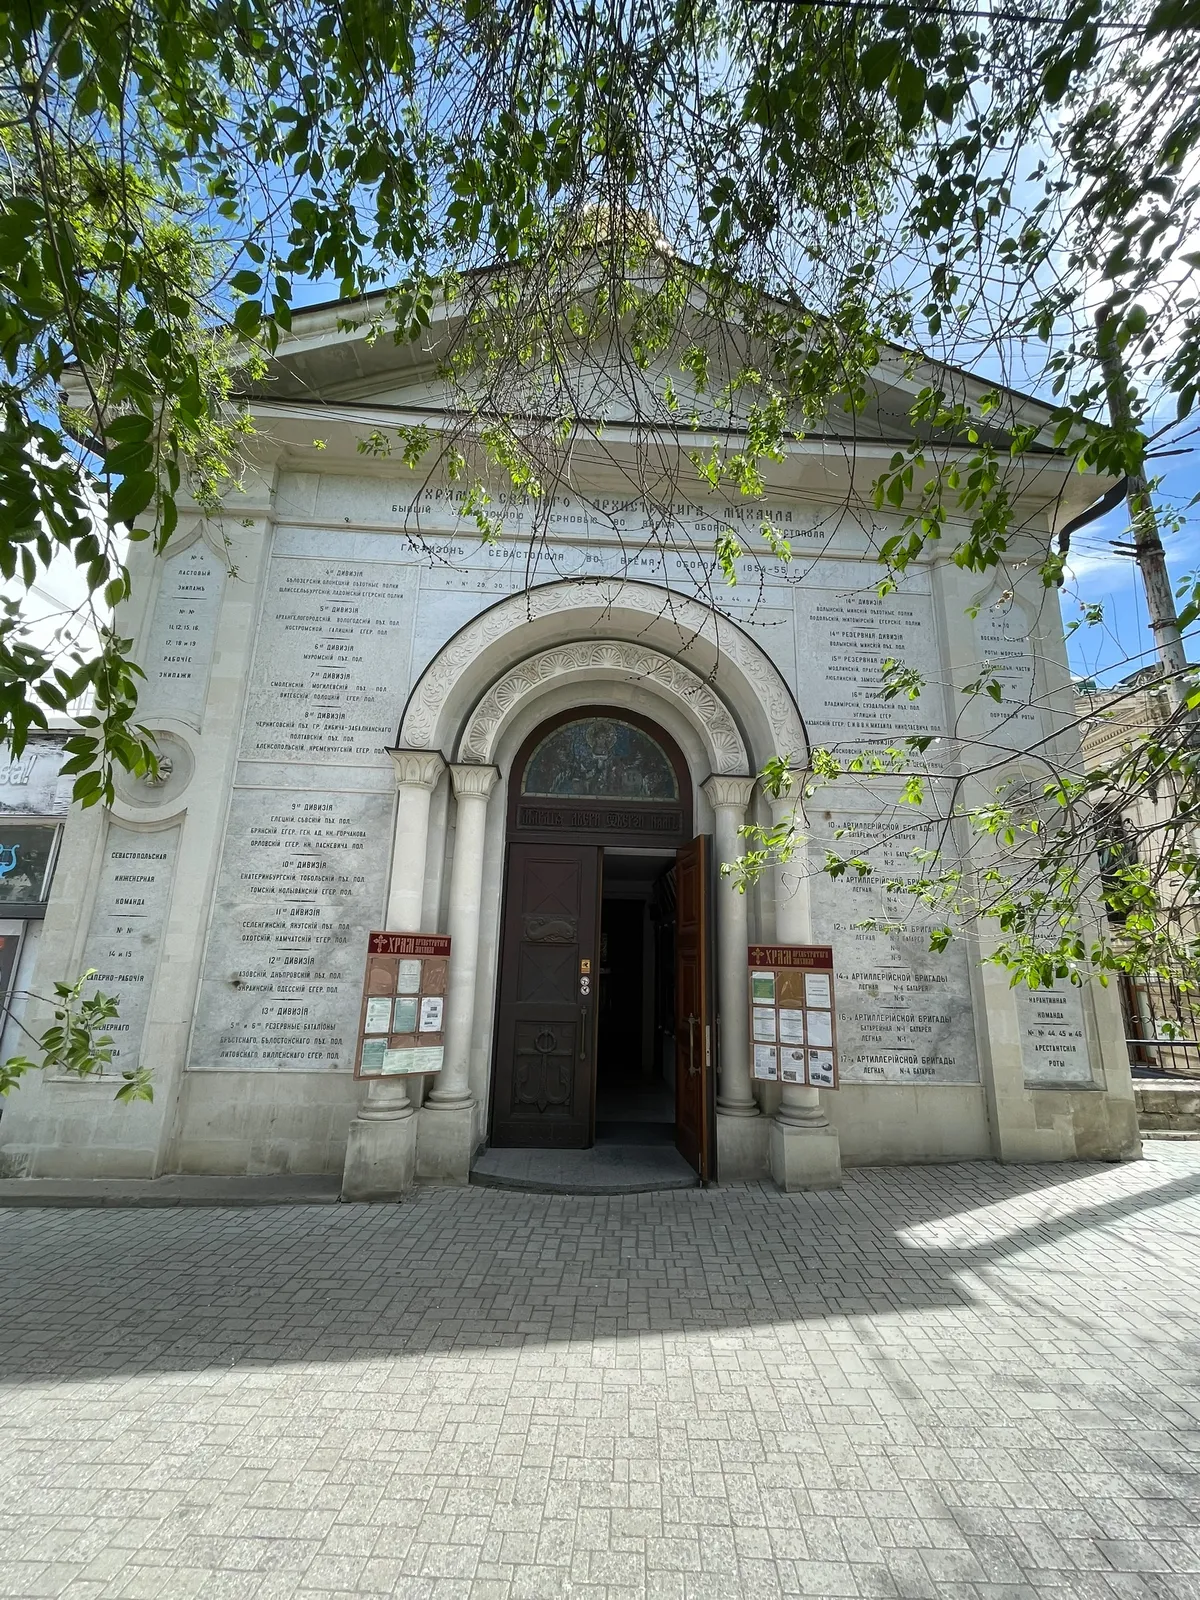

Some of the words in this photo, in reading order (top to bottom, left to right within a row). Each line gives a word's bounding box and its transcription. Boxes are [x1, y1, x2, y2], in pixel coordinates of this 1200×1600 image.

[586, 555, 599, 563] ВО
[326, 644, 354, 652] ДИВИЗІЯ
[322, 672, 351, 680] ДИВИЗІЯ
[317, 712, 346, 720] ДИВИЗІЯ
[111, 852, 167, 860] СЕВАСТОПОЛЬСКАЯ
[296, 861, 327, 869] ДИВИЗІЯ
[289, 908, 321, 916] ДИВИЗІЯ
[388, 937, 415, 954] ХРАМ
[283, 956, 315, 965] ДИВИЗІЯ
[765, 949, 792, 965] ХРАМ
[914, 974, 948, 983] БРИГАДЫ
[276, 1007, 309, 1016] ДИВИЗІЯ
[918, 1015, 952, 1024] БРИГАДЫ
[921, 1056, 956, 1065] БРИГАДЫ
